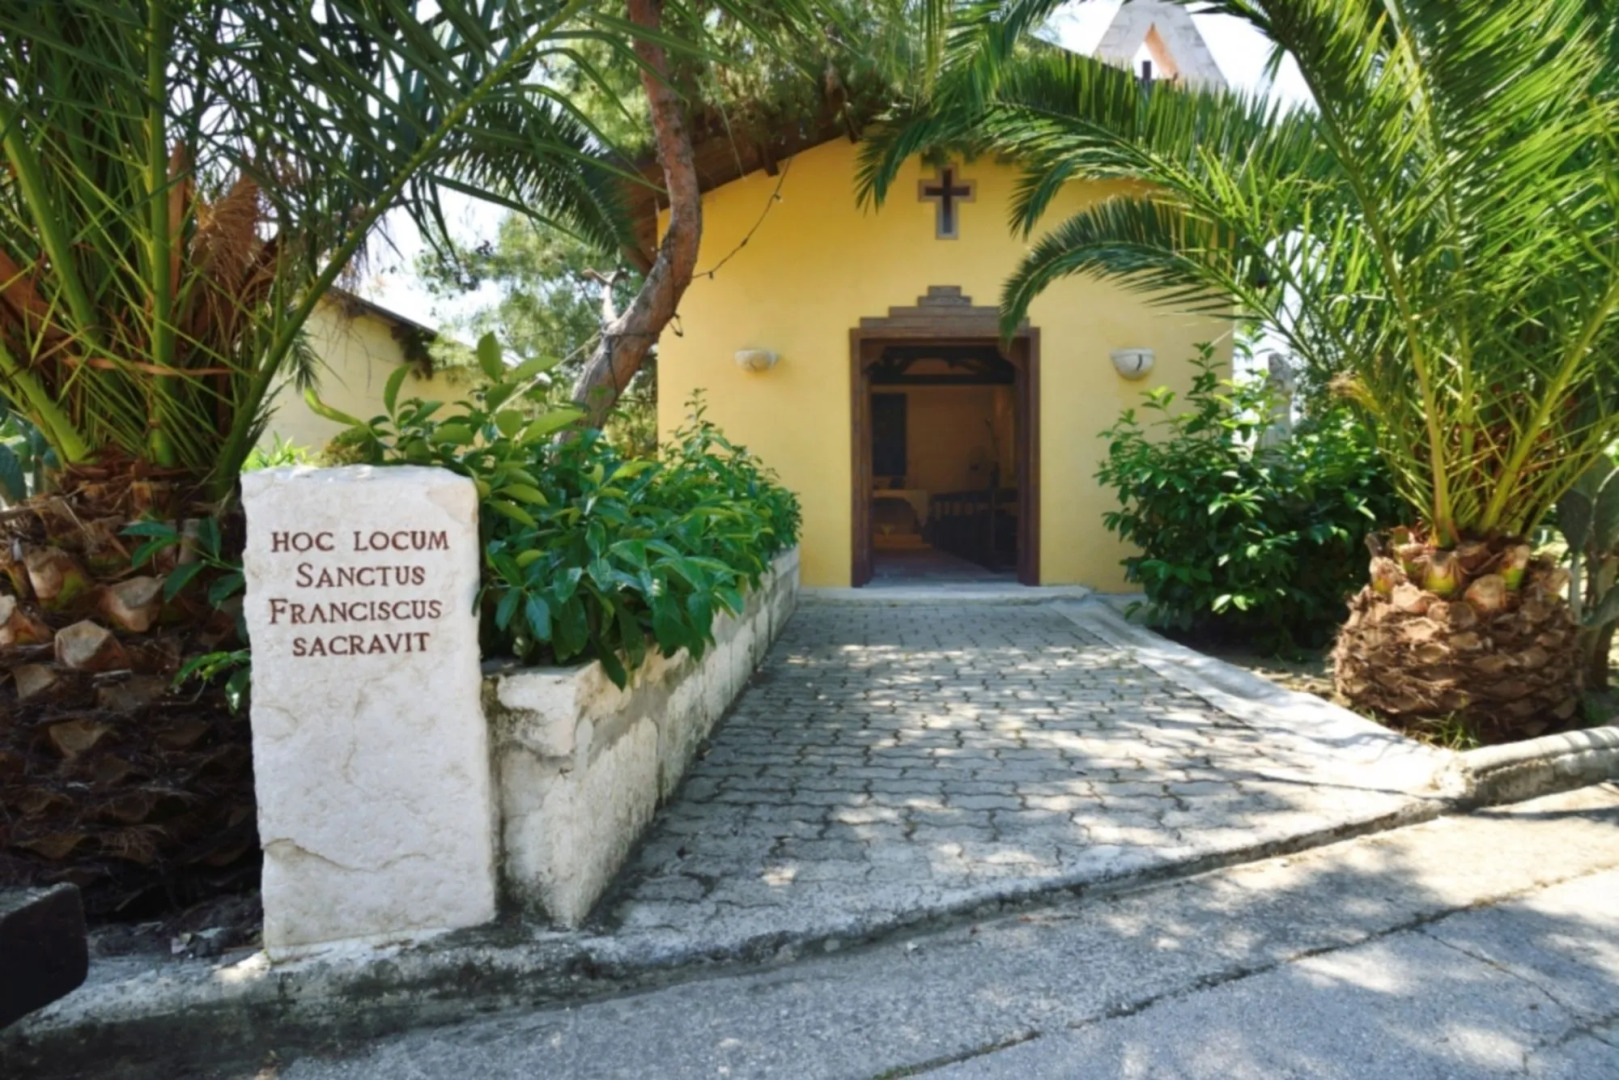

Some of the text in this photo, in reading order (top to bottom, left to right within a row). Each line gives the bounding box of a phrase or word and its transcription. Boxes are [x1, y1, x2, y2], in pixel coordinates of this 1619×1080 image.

[271, 531, 450, 552] HOC LOCUM
[296, 562, 426, 588] SANCTUS
[268, 598, 443, 624] FRANCISCUS
[292, 632, 430, 657] SACRAVIT
